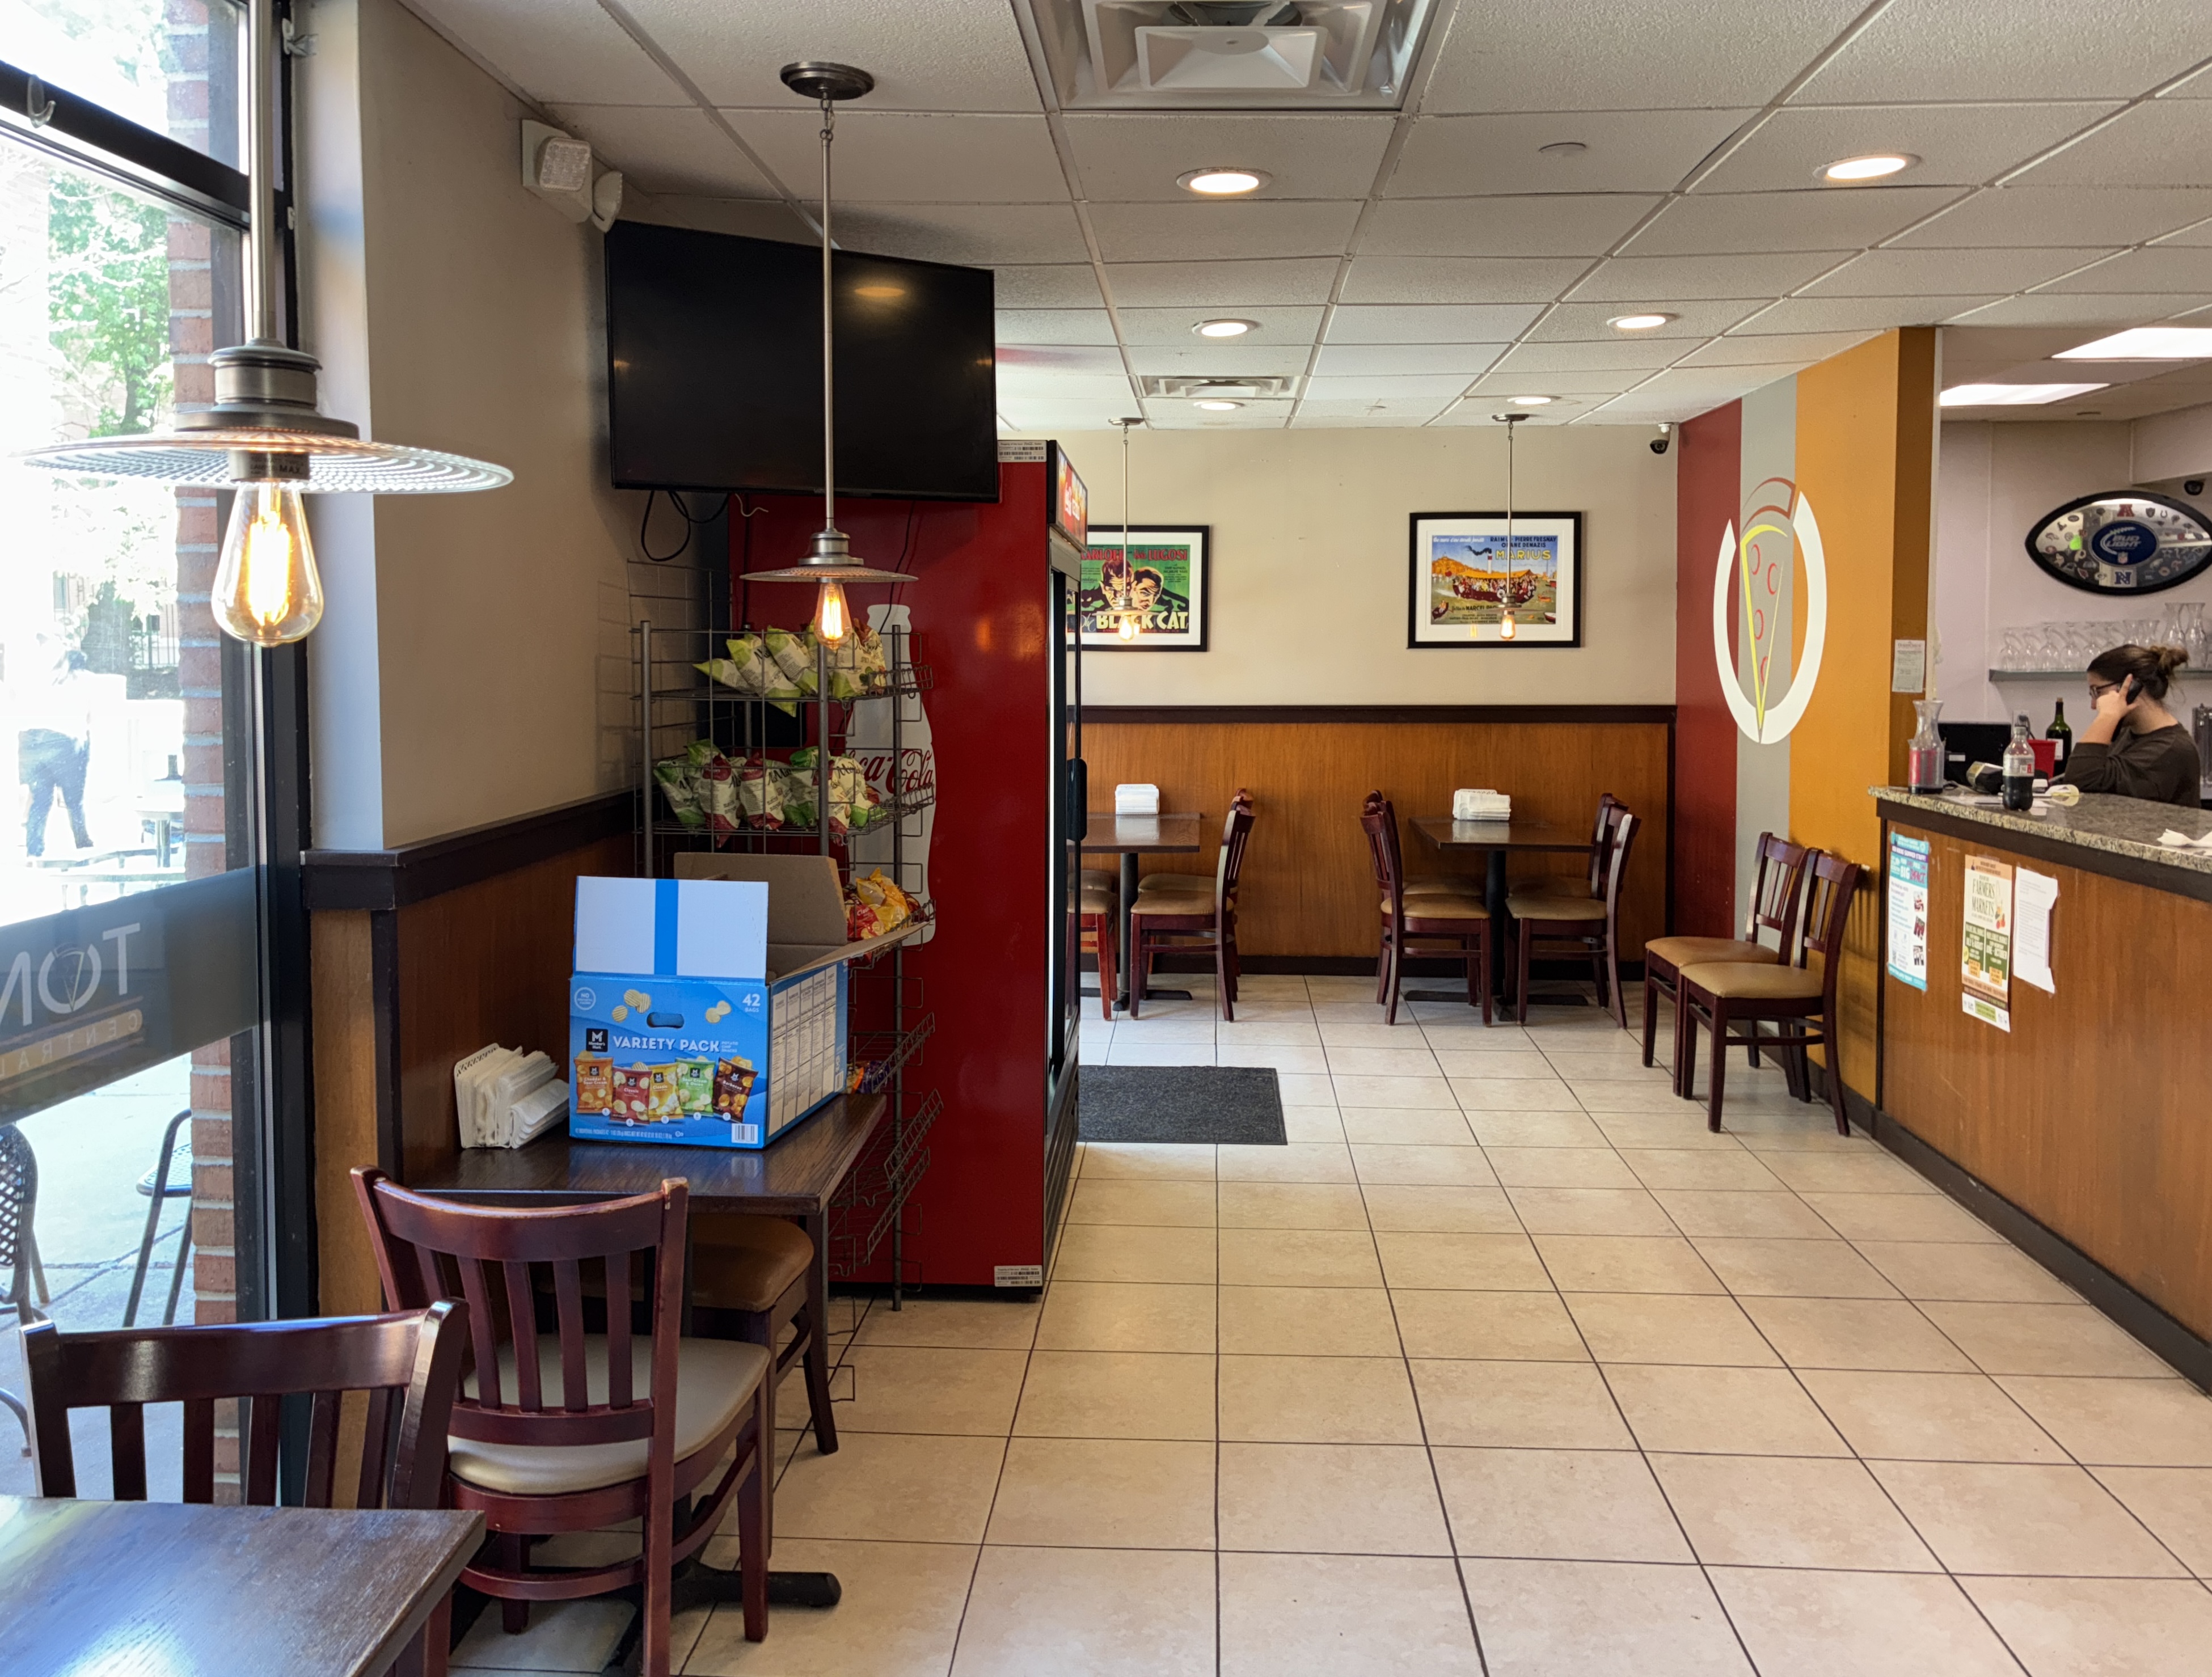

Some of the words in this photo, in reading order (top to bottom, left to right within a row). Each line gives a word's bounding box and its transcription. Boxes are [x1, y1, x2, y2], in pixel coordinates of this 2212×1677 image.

[1148, 548, 1188, 561] LUGOSI
[1495, 550, 1552, 560] MARIUS
[1156, 611, 1189, 630] CAT
[742, 993, 761, 1007] 42
[613, 1036, 676, 1050] VARIETY
[679, 1038, 721, 1053] PACK
[722, 1080, 742, 1091] Barbecue
